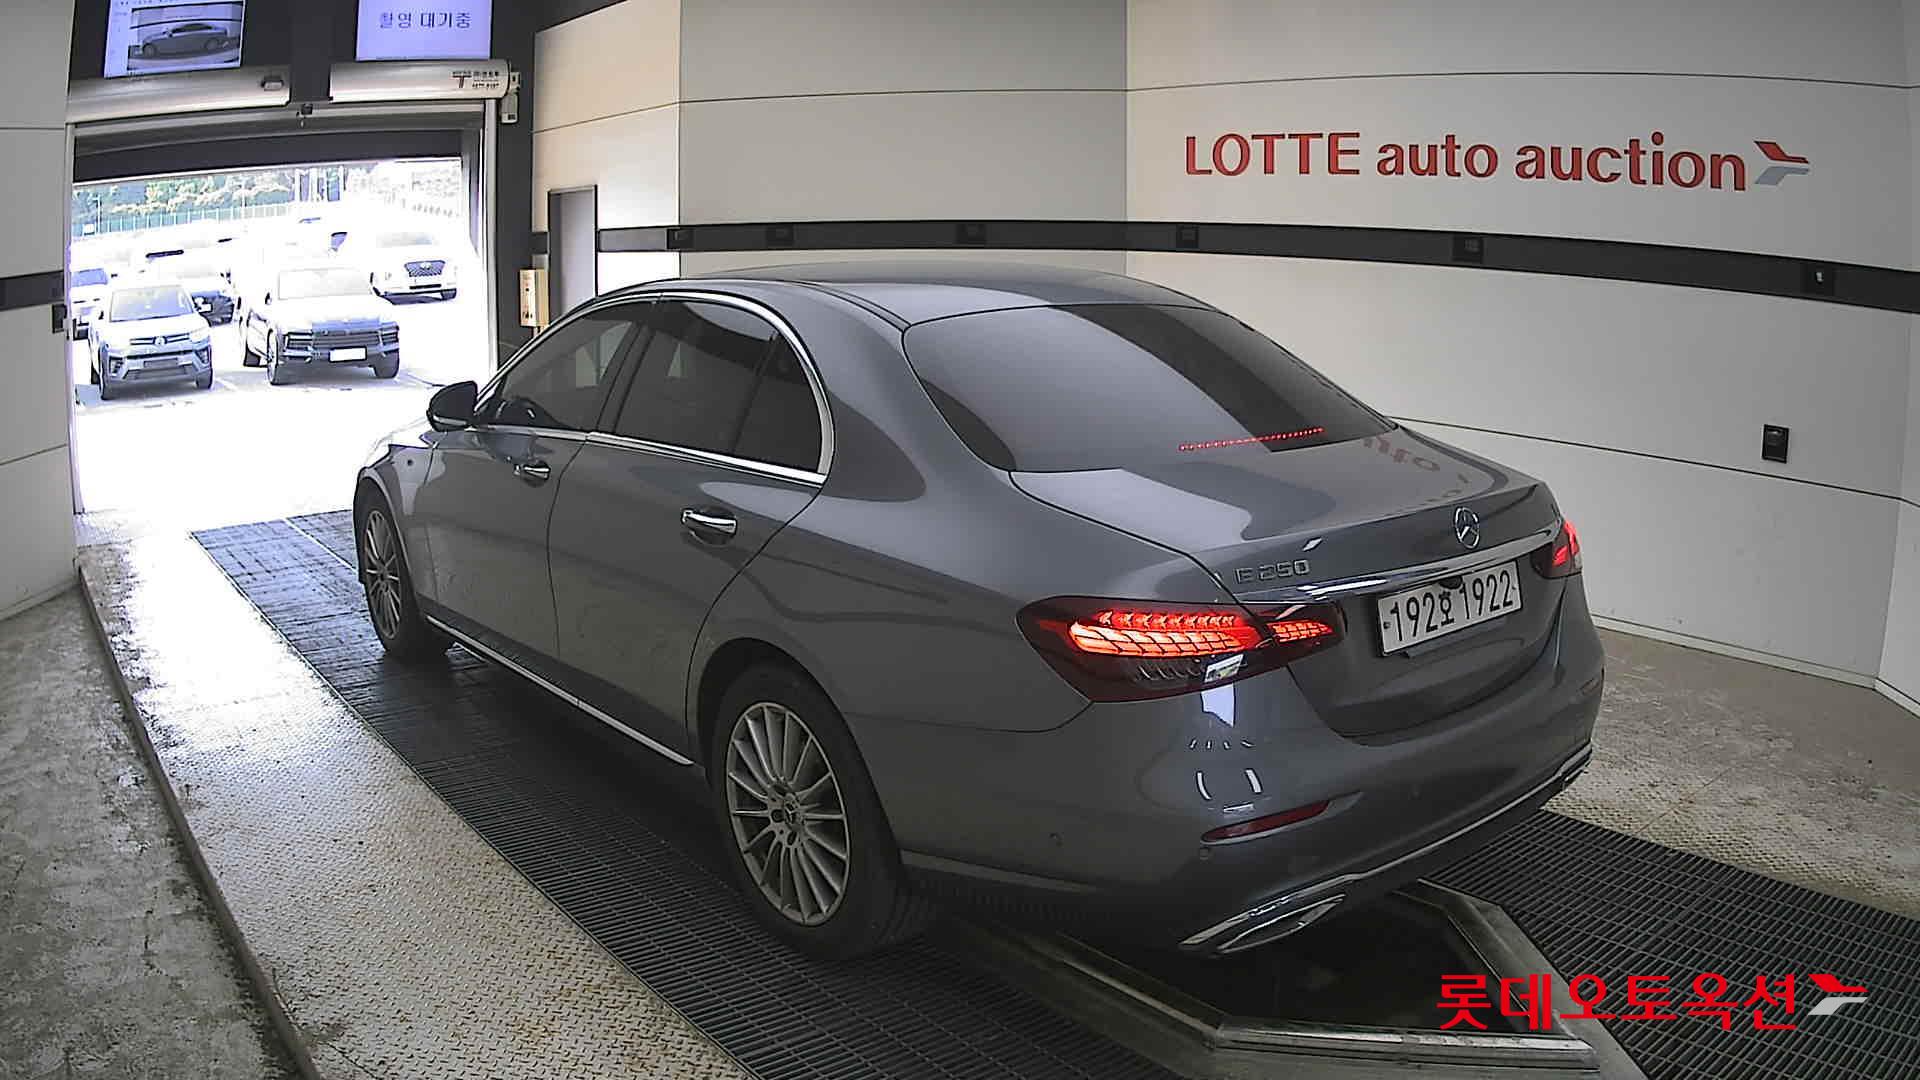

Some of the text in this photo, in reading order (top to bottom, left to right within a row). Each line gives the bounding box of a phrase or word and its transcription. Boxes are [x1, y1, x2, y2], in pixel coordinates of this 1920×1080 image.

[420, 12, 471, 29] 대기중
[1185, 132, 1746, 191] LOTTE auto auction
[1258, 559, 1310, 581] 250
[1390, 569, 1513, 642] 192호 1922
